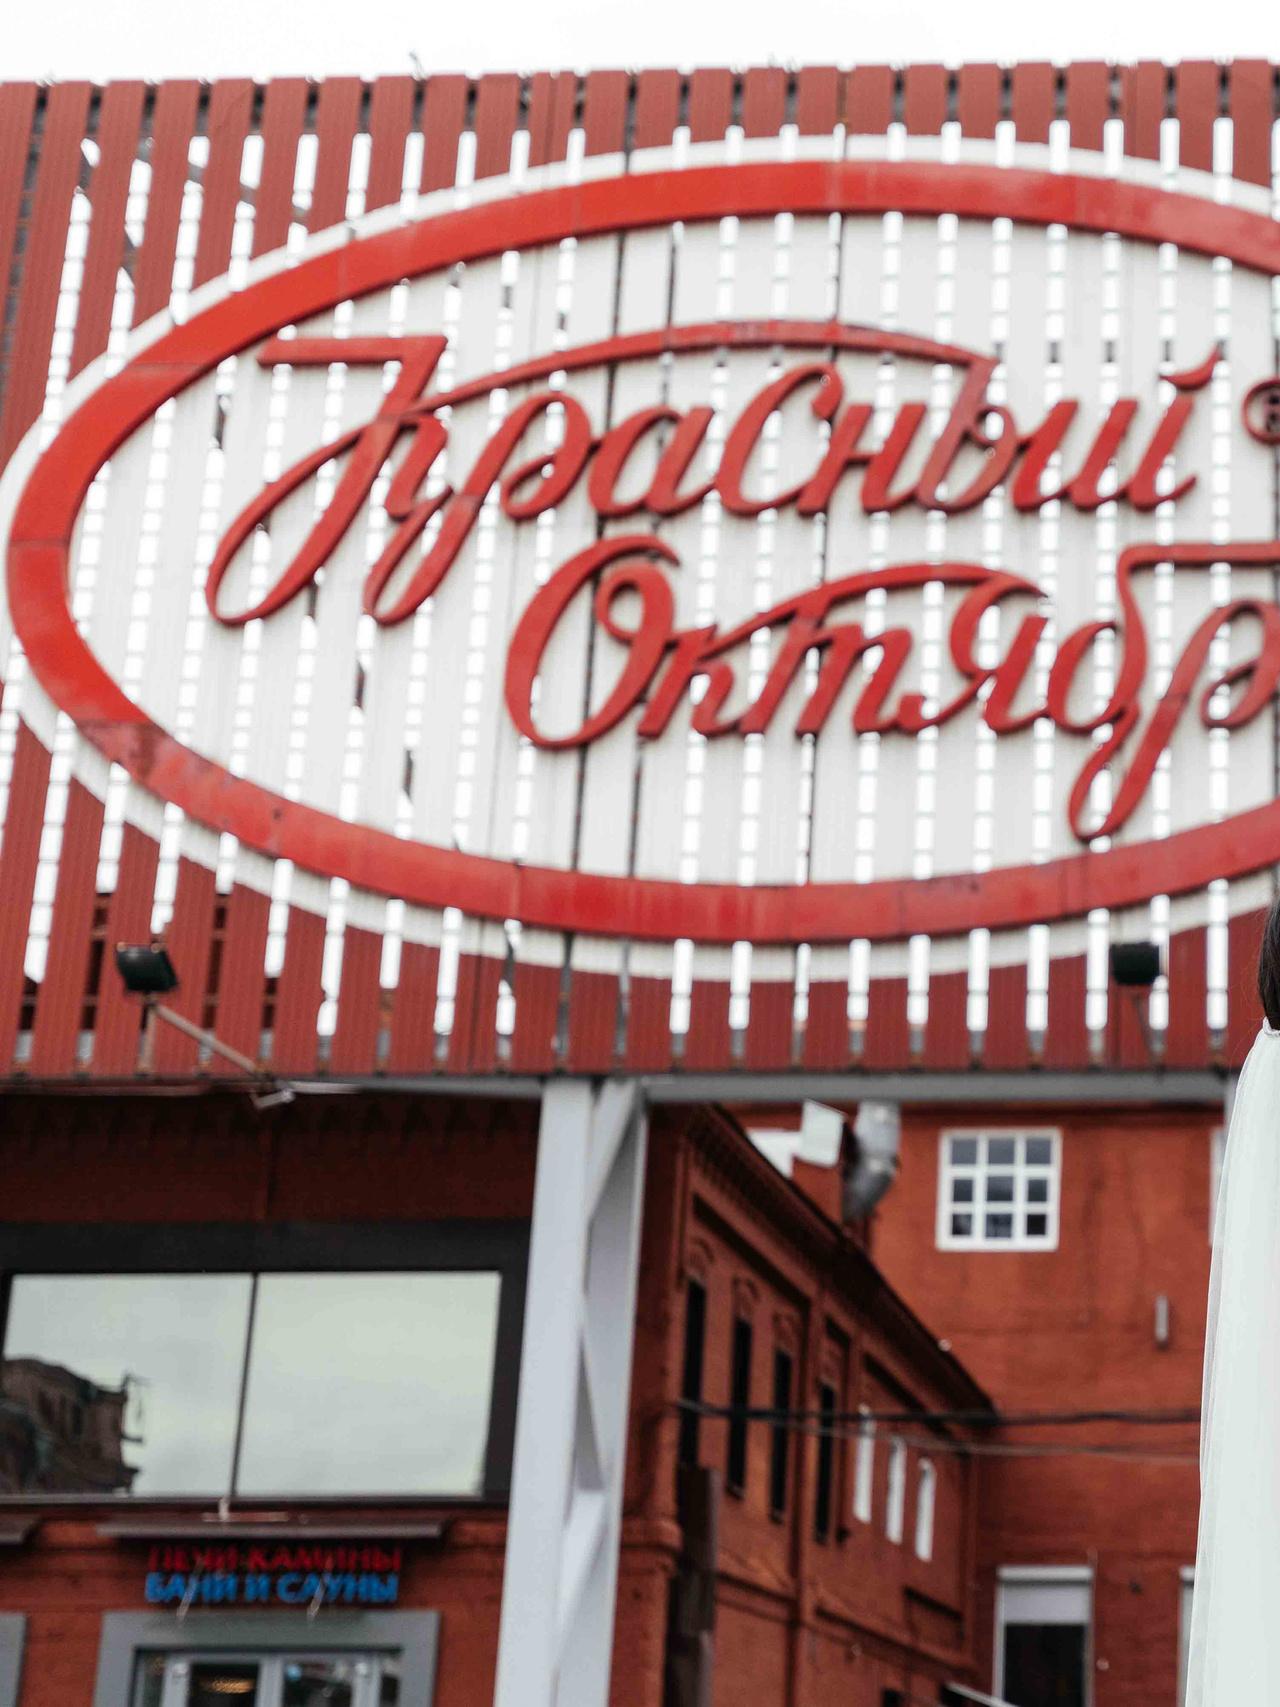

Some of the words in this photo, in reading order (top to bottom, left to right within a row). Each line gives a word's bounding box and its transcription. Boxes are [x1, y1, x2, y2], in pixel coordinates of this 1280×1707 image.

[205, 320, 1223, 629] Красный
[145, 1572, 237, 1603] БАНИ
[245, 1573, 270, 1602] И
[277, 1572, 399, 1603] САУНЫ
